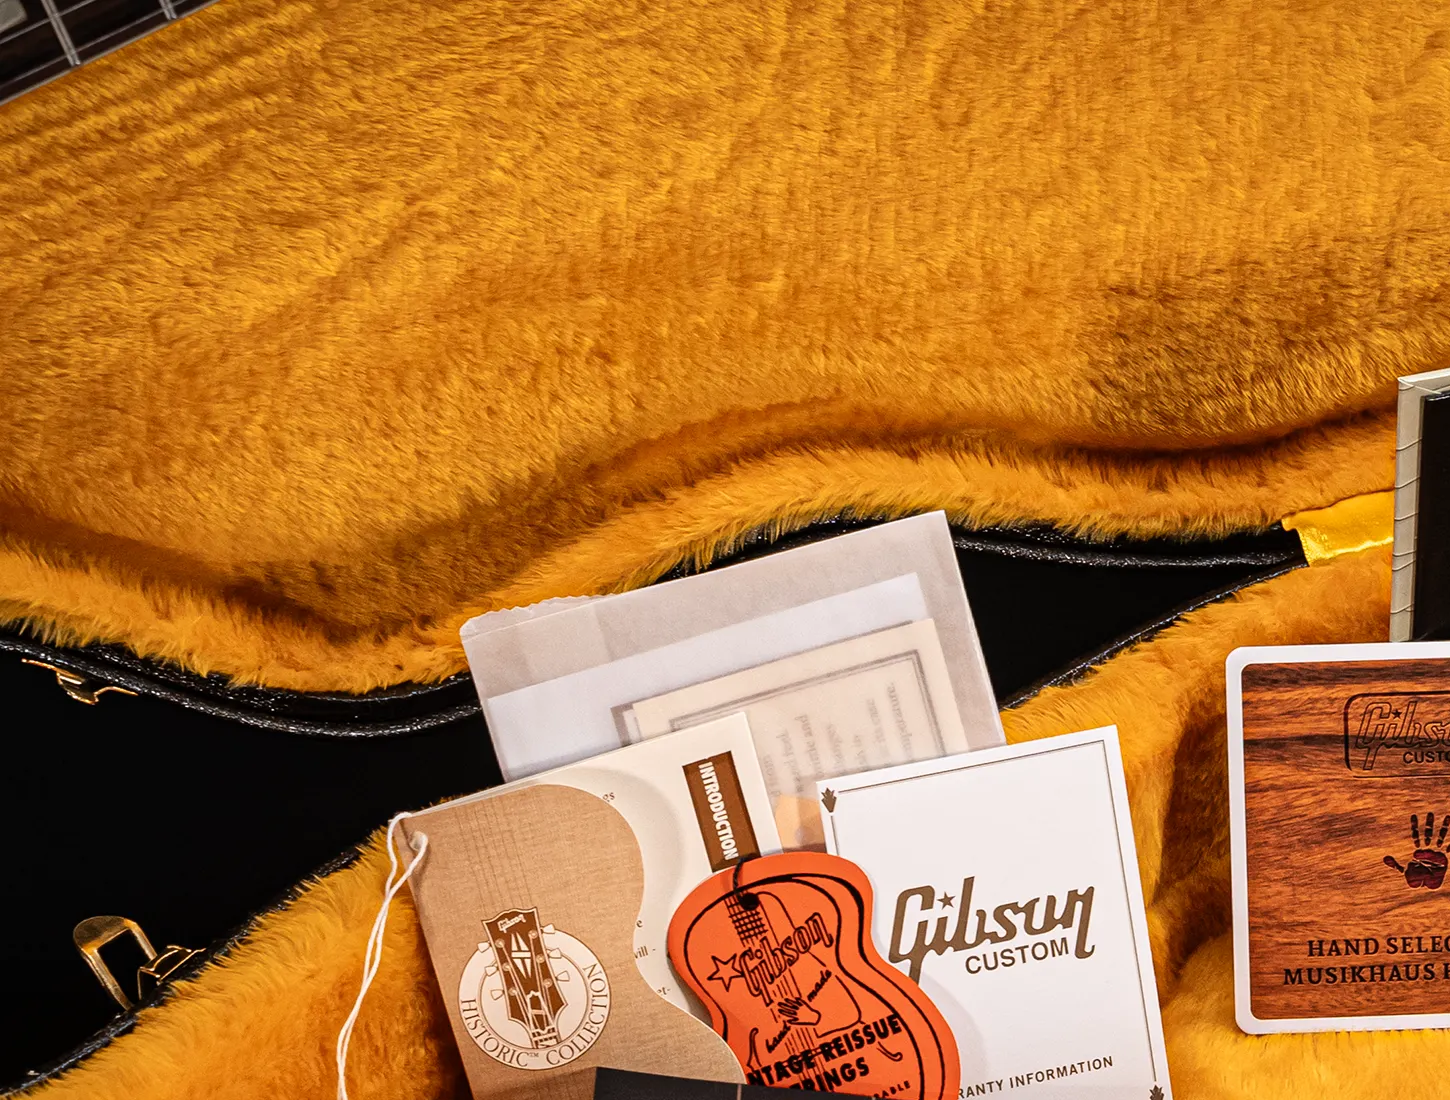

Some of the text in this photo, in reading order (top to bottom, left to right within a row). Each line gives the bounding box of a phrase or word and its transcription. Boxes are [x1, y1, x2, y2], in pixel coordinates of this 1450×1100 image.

[697, 761, 740, 861] INTRODUCTION
[888, 876, 1096, 987] Gibson
[965, 936, 1069, 975] CUSTOM
[1306, 936, 1379, 957] HAND
[739, 911, 834, 1007] Gibson
[1282, 962, 1436, 986] MUSIKHAUS
[545, 962, 609, 1067] COLLECTION
[818, 1013, 903, 1063] REISSUE
[1009, 1055, 1114, 1089] INFORMATION
